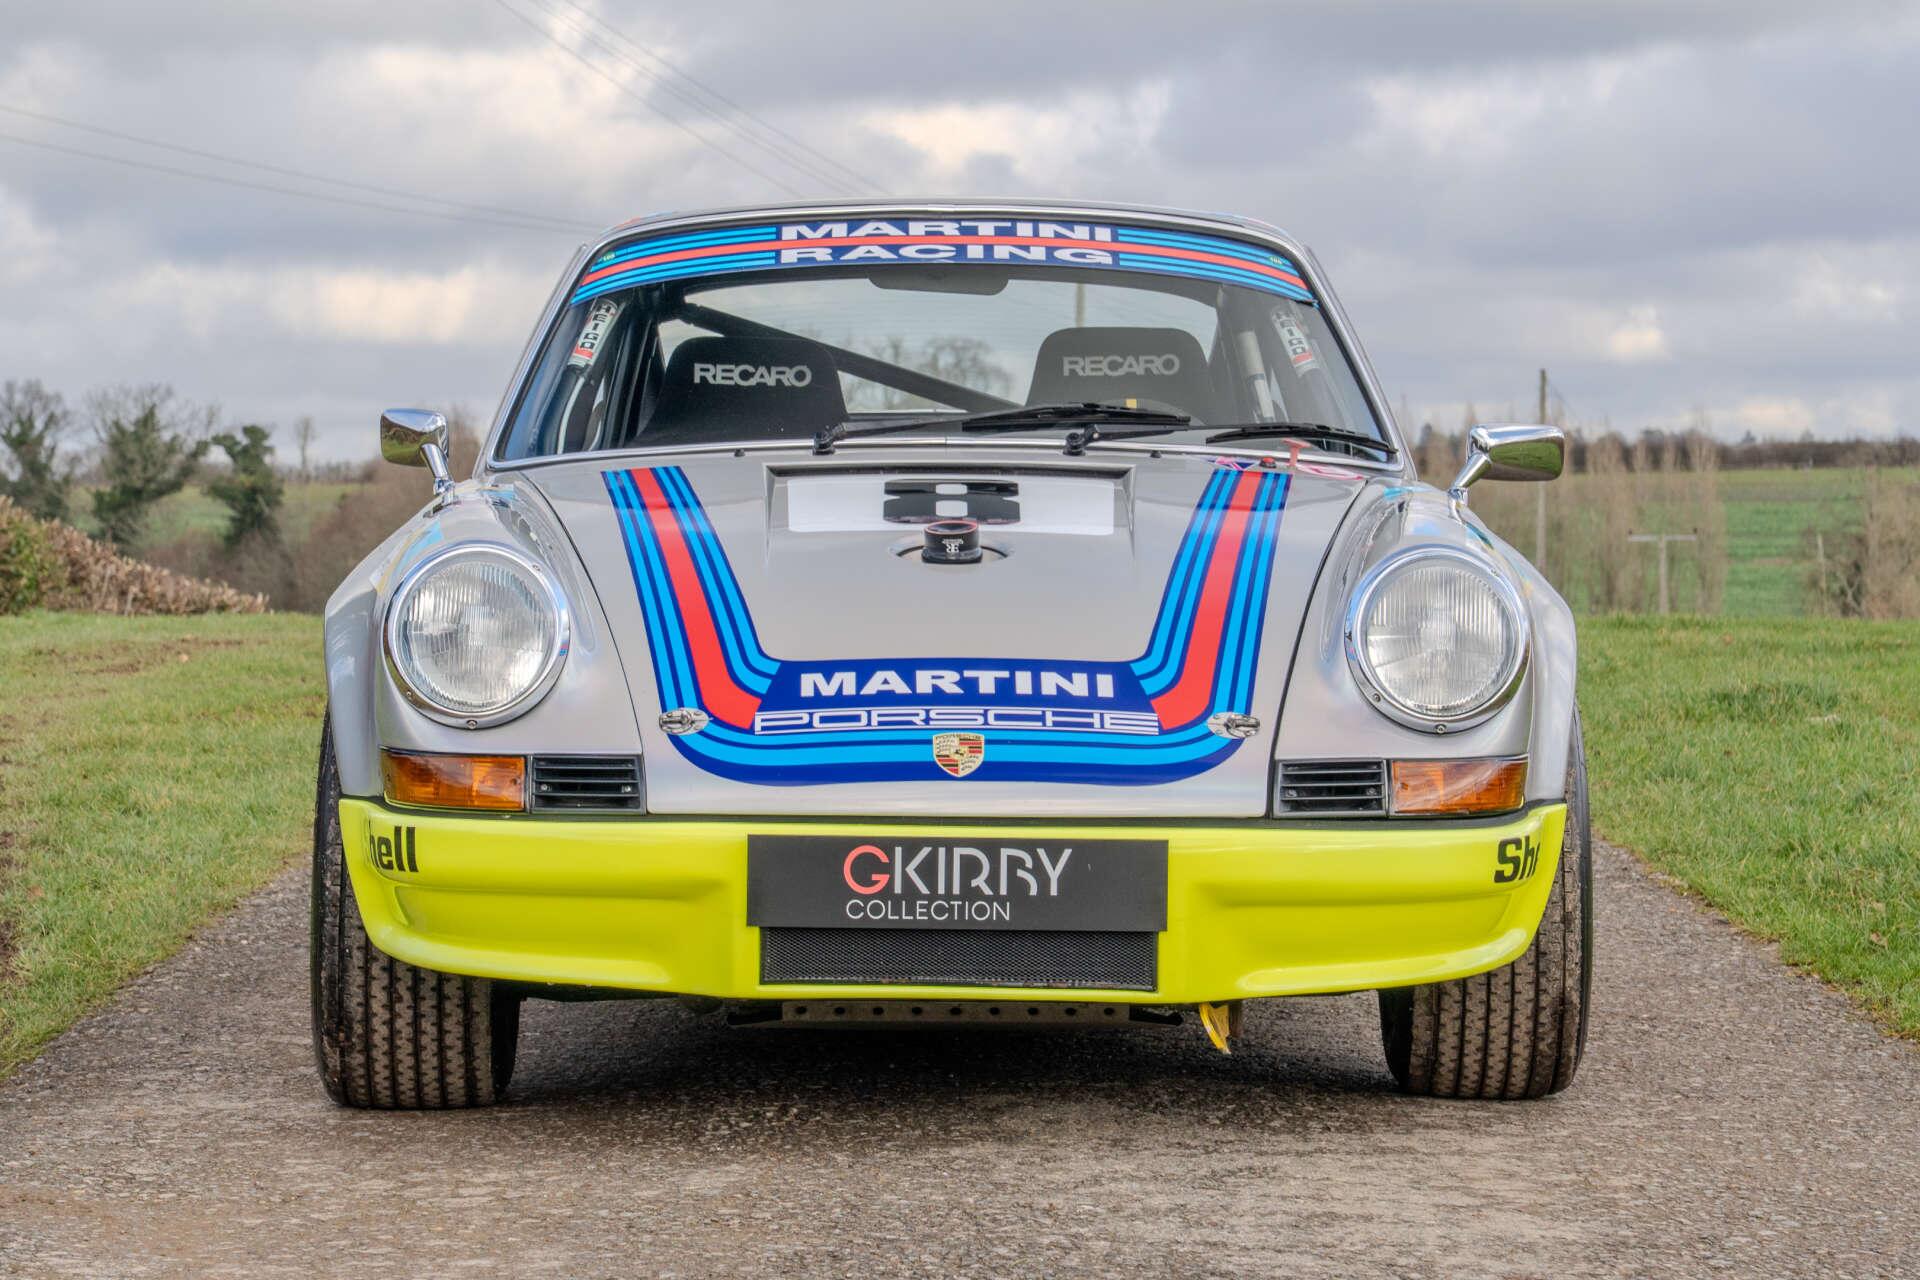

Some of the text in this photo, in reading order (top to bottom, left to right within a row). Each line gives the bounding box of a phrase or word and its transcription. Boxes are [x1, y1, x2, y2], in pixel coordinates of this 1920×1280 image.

[781, 221, 1111, 241] MARTINI
[780, 245, 1113, 264] RACING
[693, 363, 812, 386] RECARO
[1063, 354, 1180, 376] RECARO
[801, 670, 1113, 698] MARTINI
[755, 709, 1159, 733] PORSCHE
[845, 899, 1011, 922] COLLECTION
